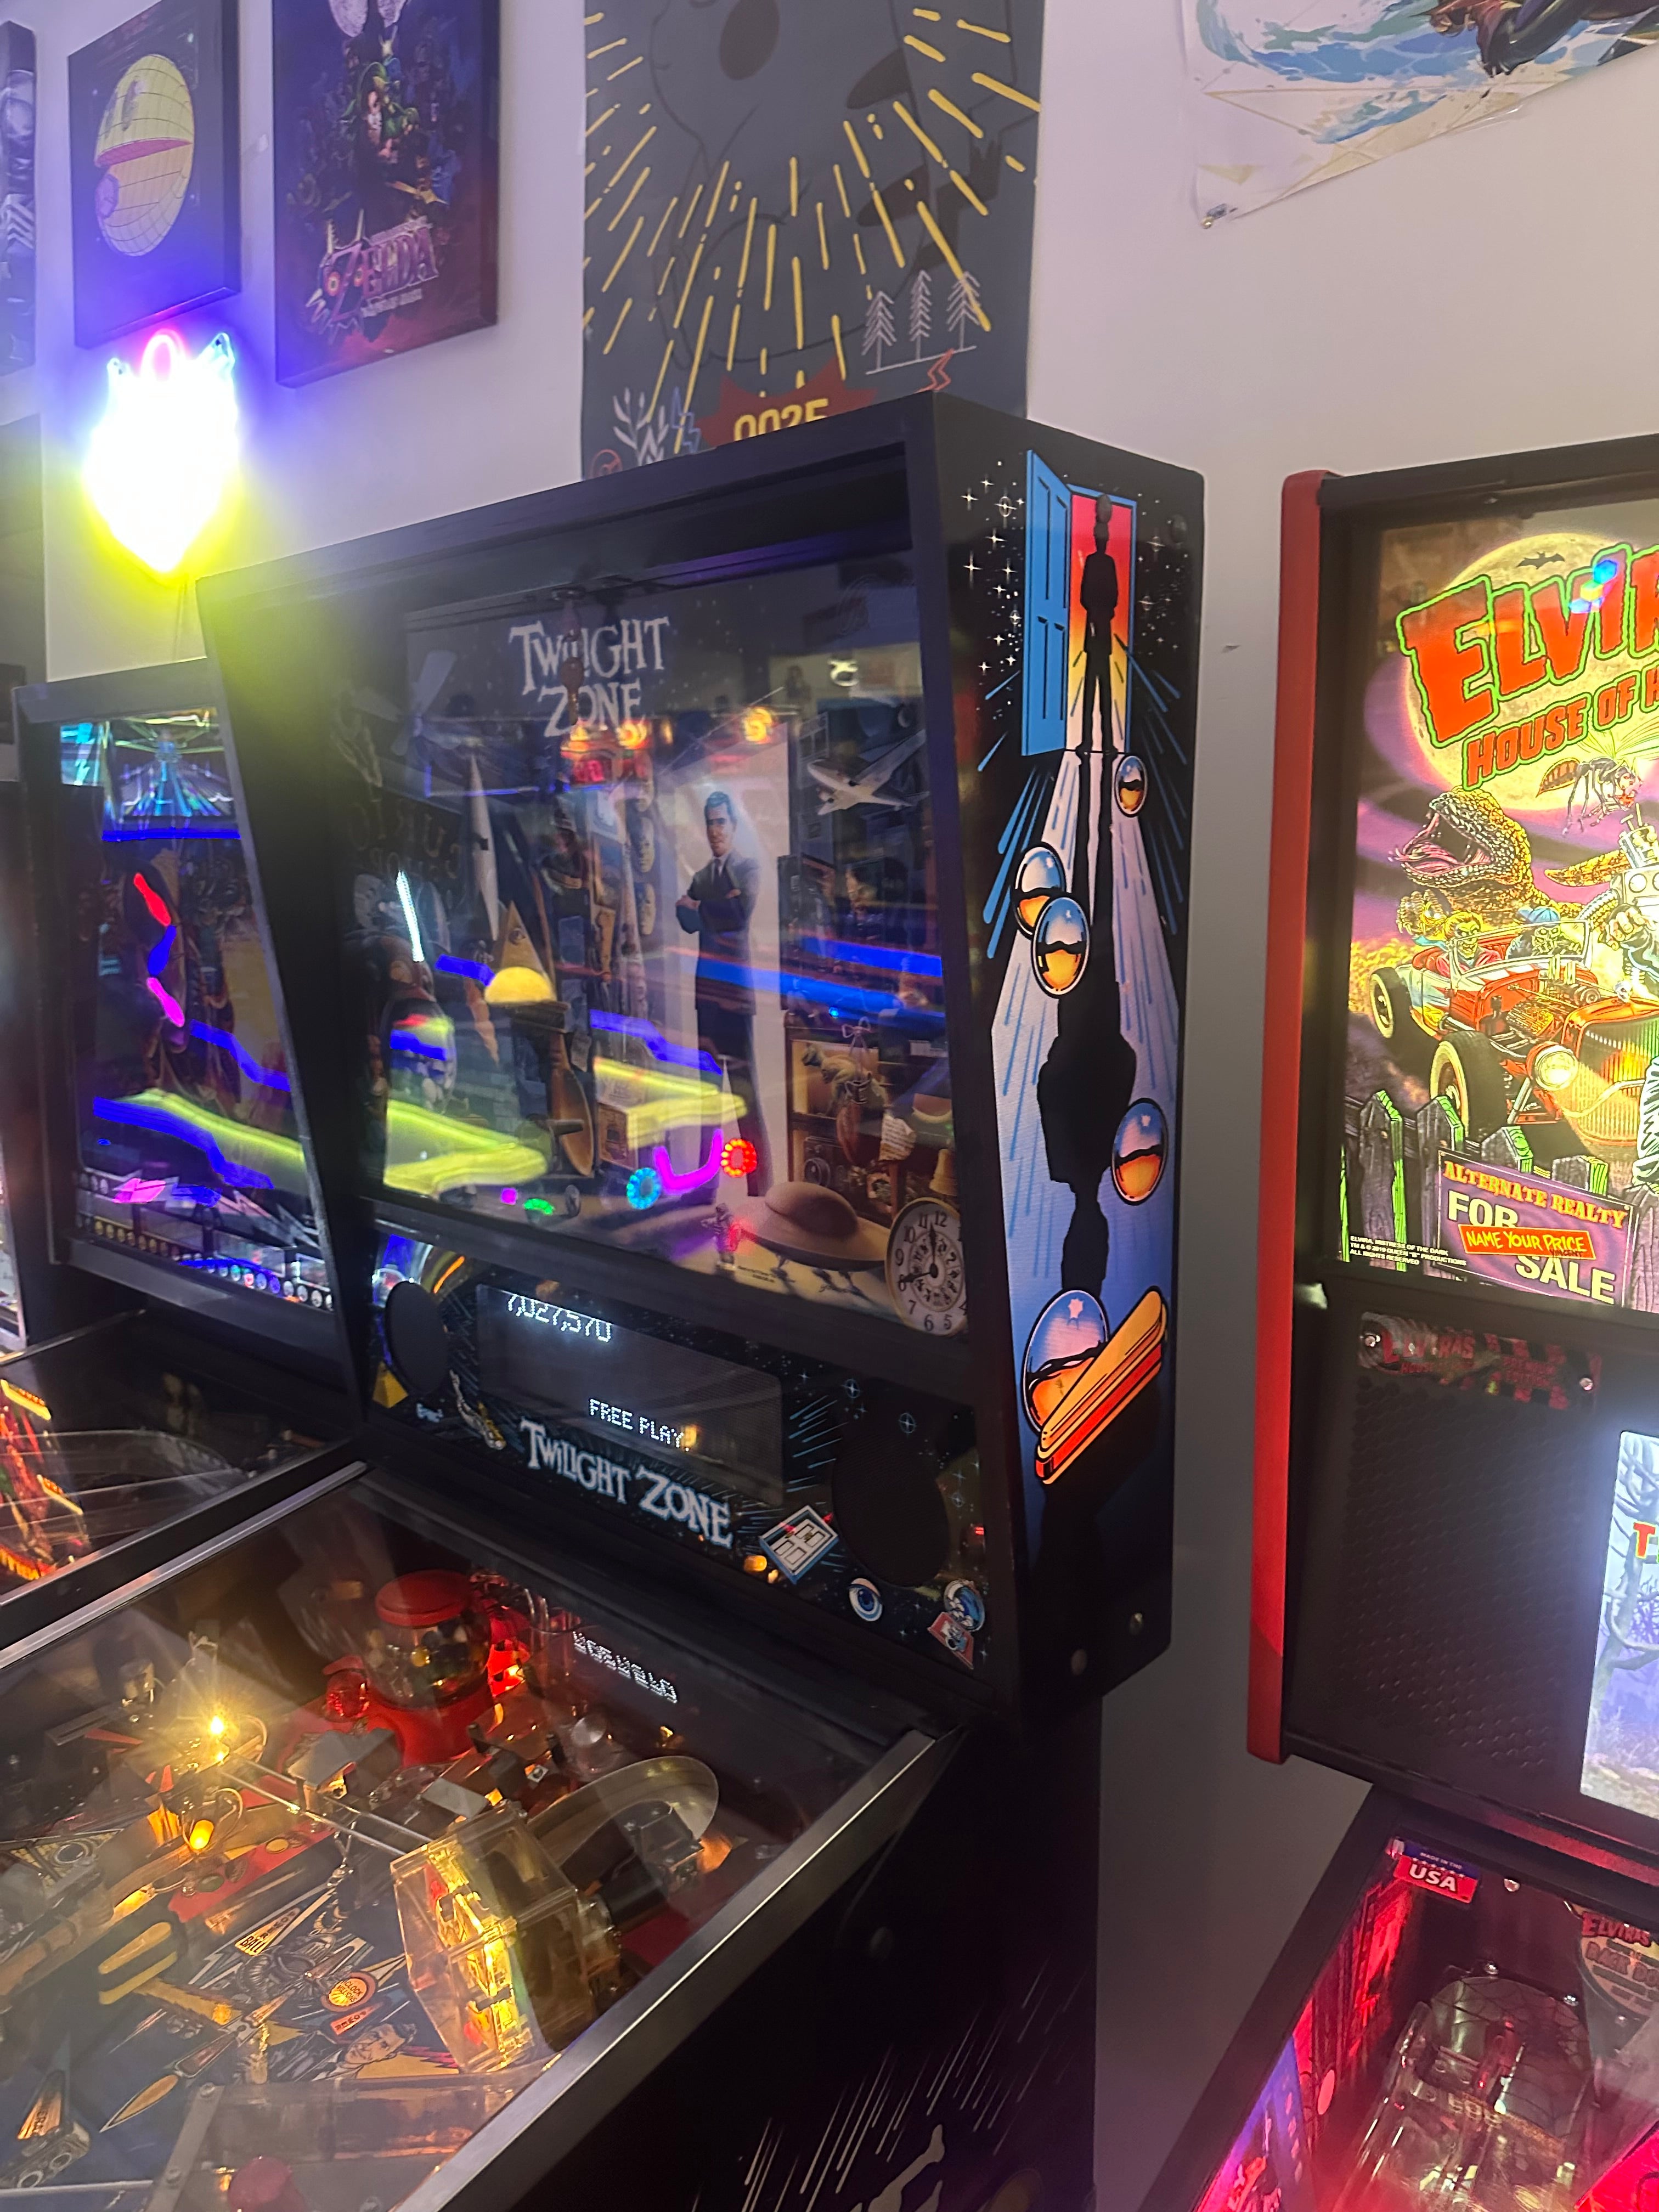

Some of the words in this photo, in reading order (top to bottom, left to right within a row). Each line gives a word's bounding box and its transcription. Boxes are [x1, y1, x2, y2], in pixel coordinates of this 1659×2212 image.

[537, 678, 645, 738] ZONE
[1464, 695, 1590, 788] HOUSE
[1595, 673, 1639, 728] OF
[1443, 1160, 1548, 1207] ALTERNATE
[1551, 1194, 1628, 1229] REALTY
[1448, 1190, 1518, 1228] FOR
[918, 1214, 928, 1229] 11
[934, 1212, 947, 1227] 12
[904, 1226, 916, 1243] 10
[1466, 1231, 1503, 1248] NAME
[1503, 1231, 1543, 1251] YOUR
[1543, 1234, 1587, 1252] PRICE
[895, 1249, 904, 1267] 9
[1363, 1251, 1385, 1260] RIGHTS
[1386, 1254, 1420, 1265] RESERVED
[1421, 1254, 1466, 1266] PRODUCTIONS
[1431, 1248, 1448, 1256] DARK
[898, 1274, 906, 1292] 8
[1515, 1255, 1615, 1305] SALE
[908, 1300, 917, 1315] 7
[924, 1316, 933, 1331] 6
[943, 1315, 953, 1330] 5
[590, 1399, 633, 1430] FREE
[520, 1417, 631, 1504] TWILIGHT
[636, 1464, 733, 1549] ZONE
[1409, 1864, 1455, 1892] USA
[240, 1936, 266, 1953] BALL
[345, 1981, 363, 1996] CLOCK
